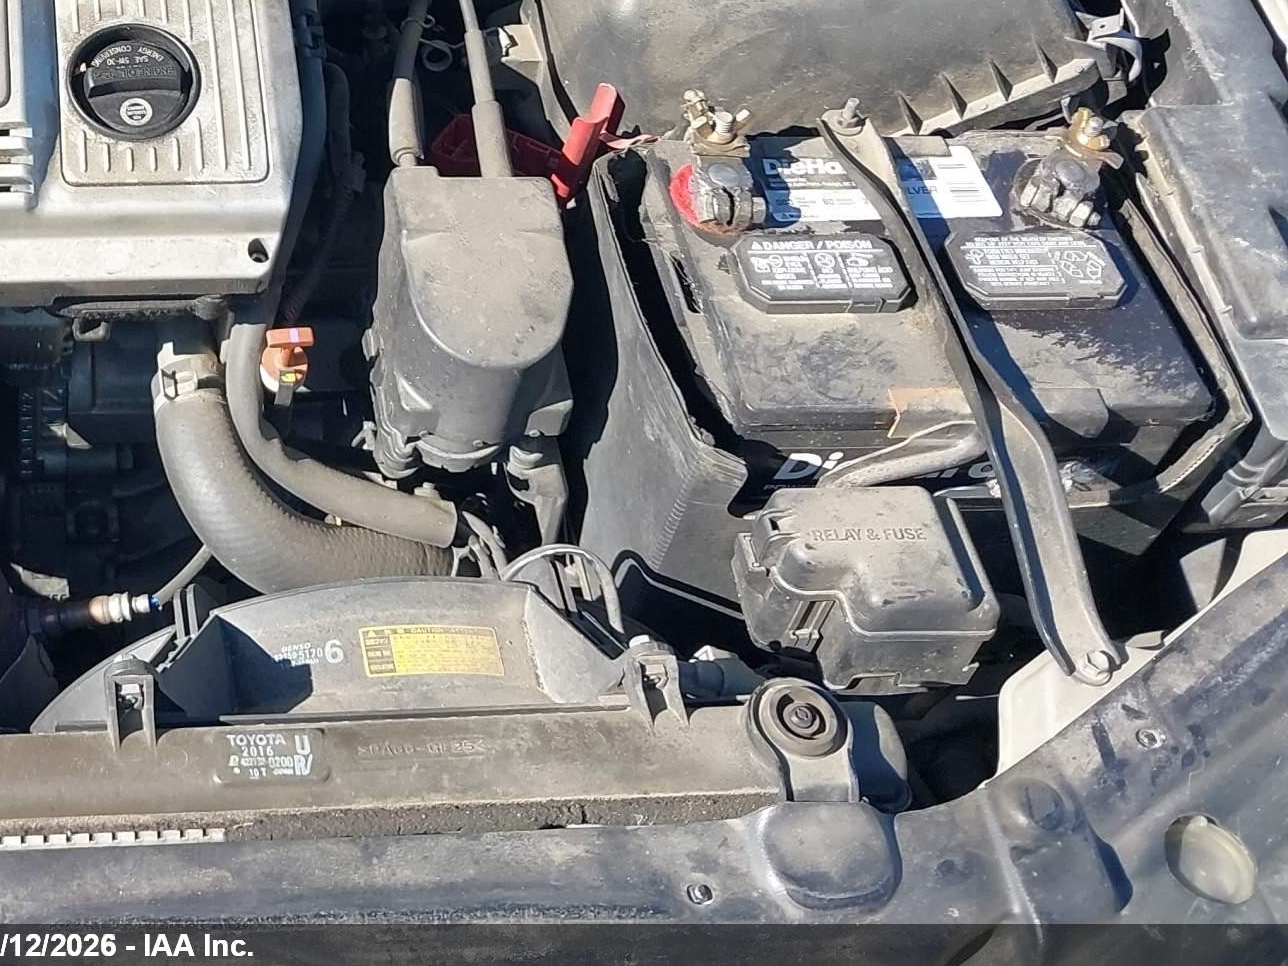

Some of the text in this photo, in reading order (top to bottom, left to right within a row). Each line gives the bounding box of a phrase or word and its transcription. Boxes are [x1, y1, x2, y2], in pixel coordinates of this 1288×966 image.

[91, 45, 165, 68] ENERGY CONSERVING
[133, 55, 149, 63] SAE
[762, 240, 813, 251] DANGER
[825, 239, 873, 250] POISON
[812, 528, 928, 543] RELAY & FUSE
[324, 638, 345, 664] 6
[226, 733, 288, 747] TOYOTA
[240, 745, 274, 757] 2016
